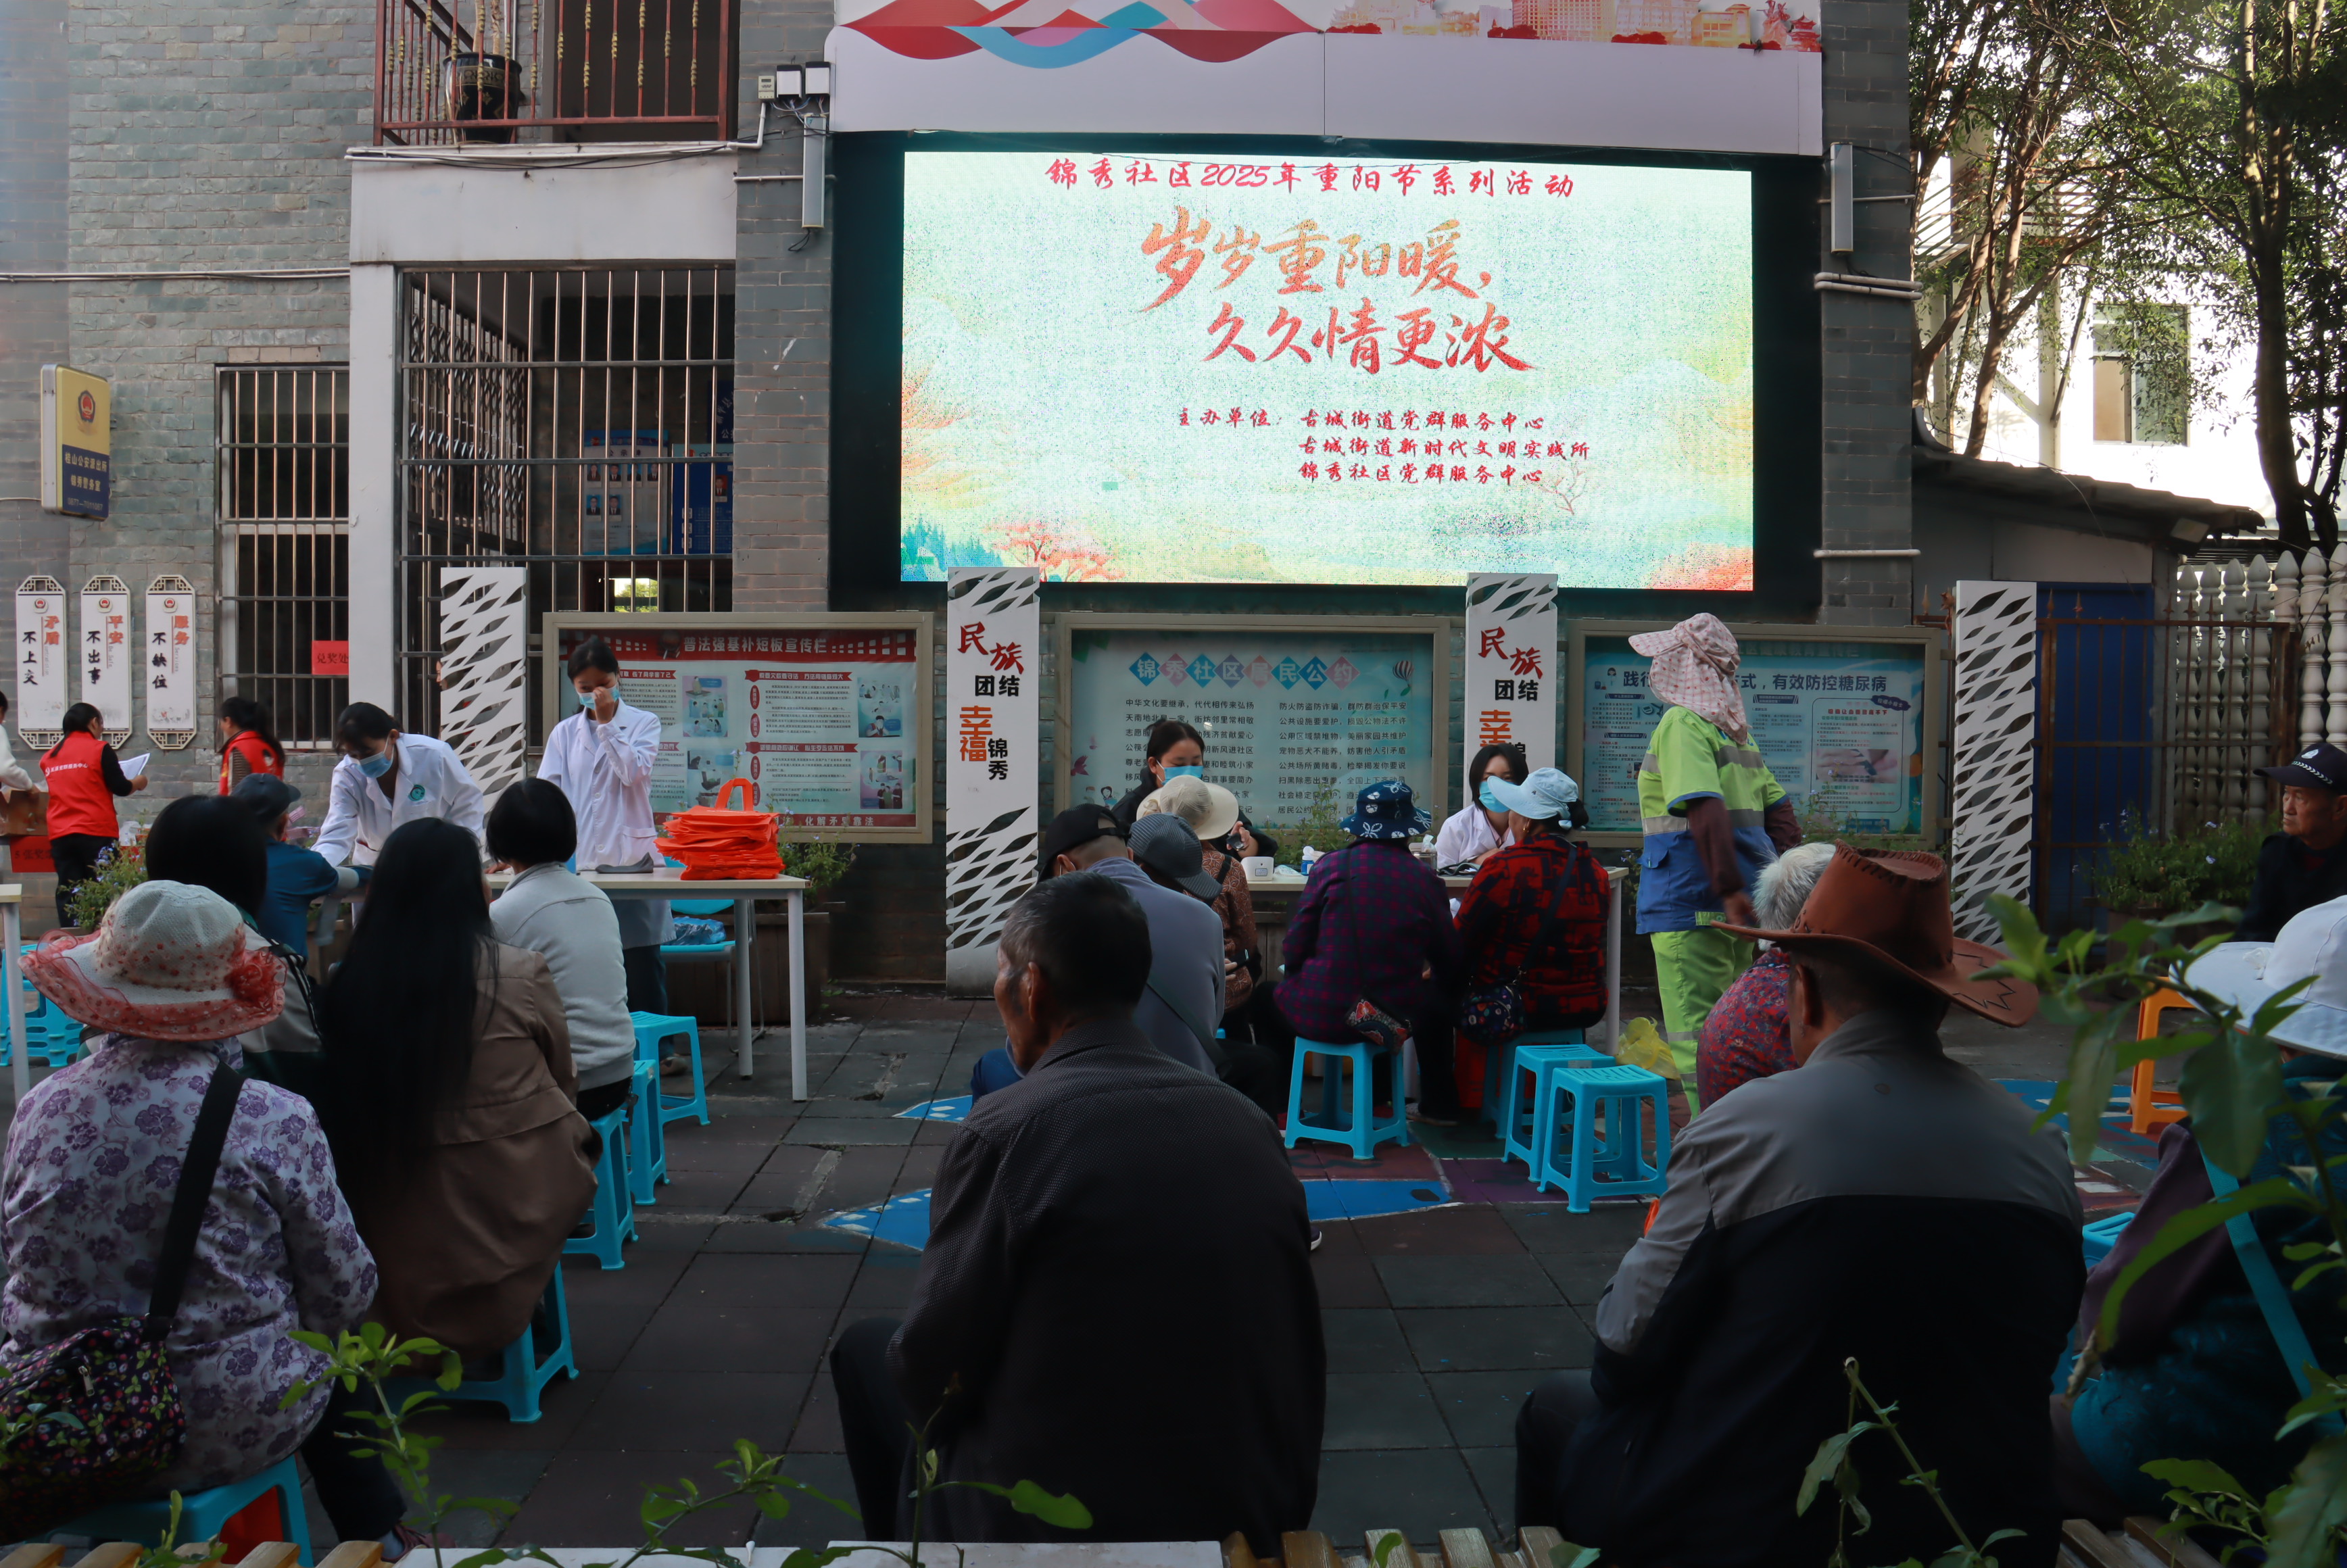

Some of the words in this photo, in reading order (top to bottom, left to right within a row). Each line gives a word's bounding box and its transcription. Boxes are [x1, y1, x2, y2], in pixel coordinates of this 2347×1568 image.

[1044, 157, 1575, 199] 锦秀社区2025年重阳节系列活动
[1202, 296, 1538, 375] 久久情更浓
[1299, 408, 1545, 433] 古城街道党群服务中心
[1298, 435, 1591, 460] 古城街道新时代文明实践所
[65, 452, 107, 472] 桂山公安派出所
[1298, 461, 1544, 484] 锦秀社区党群服务中心
[44, 615, 61, 645] 矛盾
[108, 615, 123, 644] 平安
[174, 615, 190, 645] 服务
[87, 630, 101, 685] 不出事
[683, 636, 827, 654] 普法强基补短板宣传栏
[957, 621, 1025, 675] 民族
[1478, 626, 1543, 679] 民族
[22, 630, 39, 686] 不上交
[152, 632, 168, 689] 不缺位
[1137, 659, 1353, 683] 锦秀社区居民公约
[1623, 672, 1887, 693] 践行式，有效防控糖尿病
[975, 675, 1020, 697] 团结
[1495, 679, 1539, 701] 团结
[1126, 699, 1255, 710] 中华文化要继承，代代相传来弘扬
[1279, 702, 1407, 711] 防火防盗防诈骗，群防群治保平安
[959, 705, 993, 762] 幸福
[1279, 717, 1407, 726] 公共设施要爱护，损毁公物法不许
[1479, 710, 1512, 747] 幸
[1279, 732, 1407, 741] 公用区域禁堆物，美丽家园共维护
[988, 738, 1009, 781] 锦秀
[1279, 746, 1407, 756] 宠物恶犬不能养，妨害他人引矛盾
[1279, 761, 1407, 770] 公共场所黄赌毒，检举揭发你要说
